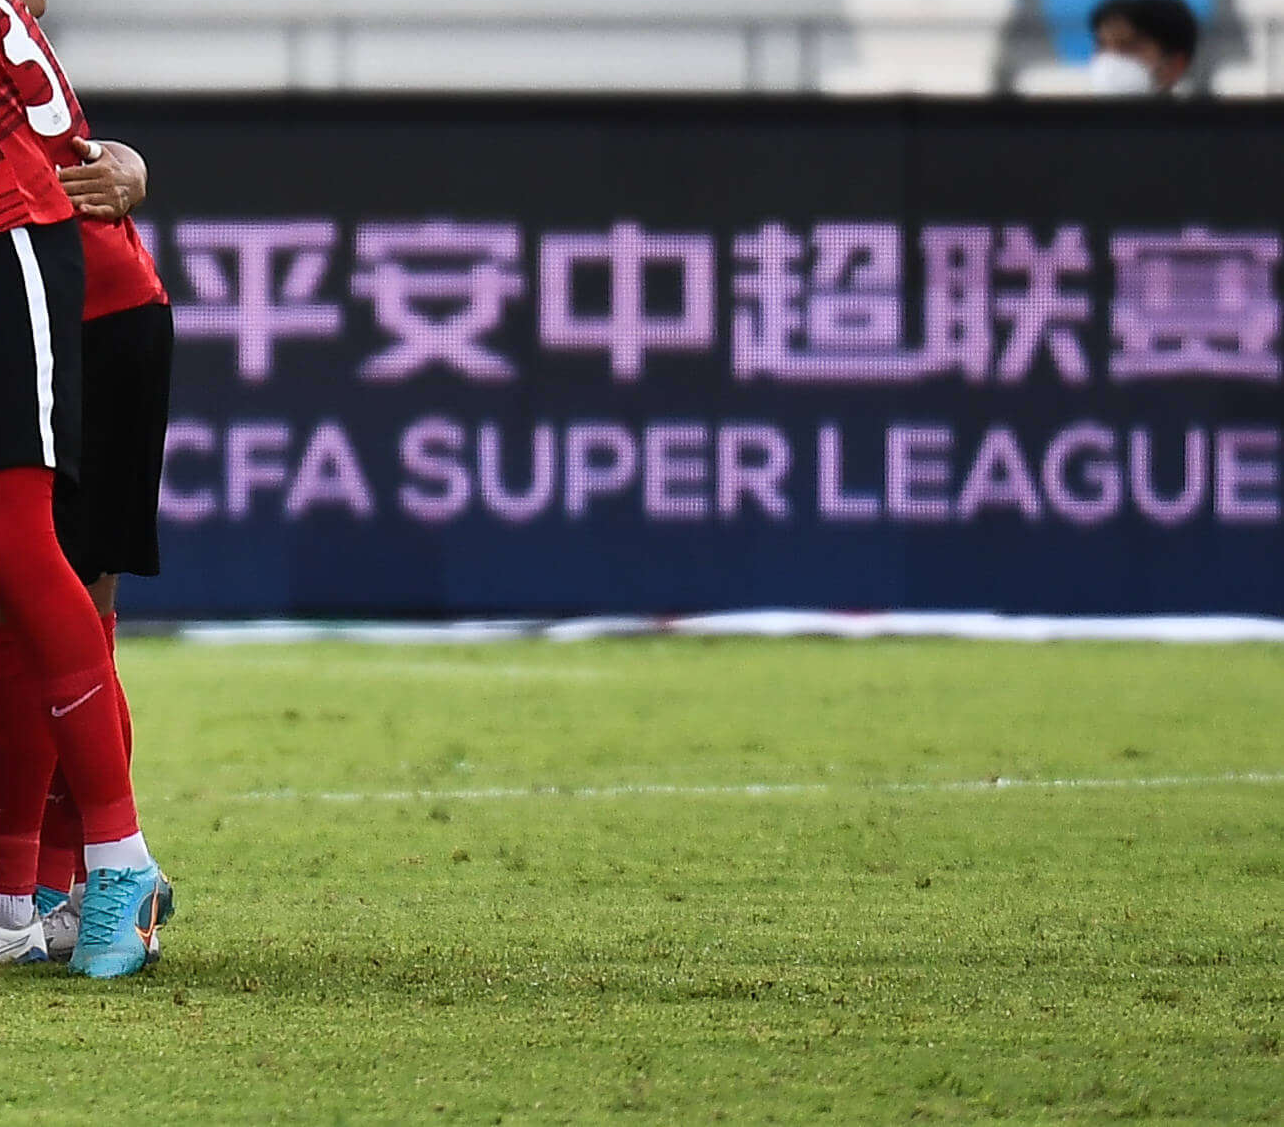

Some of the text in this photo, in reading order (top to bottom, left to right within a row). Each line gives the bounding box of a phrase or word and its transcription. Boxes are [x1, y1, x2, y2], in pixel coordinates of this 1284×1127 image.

[137, 219, 1283, 383] 平安中超联赛
[157, 413, 1283, 524] CFA SUPER LEAGUE
